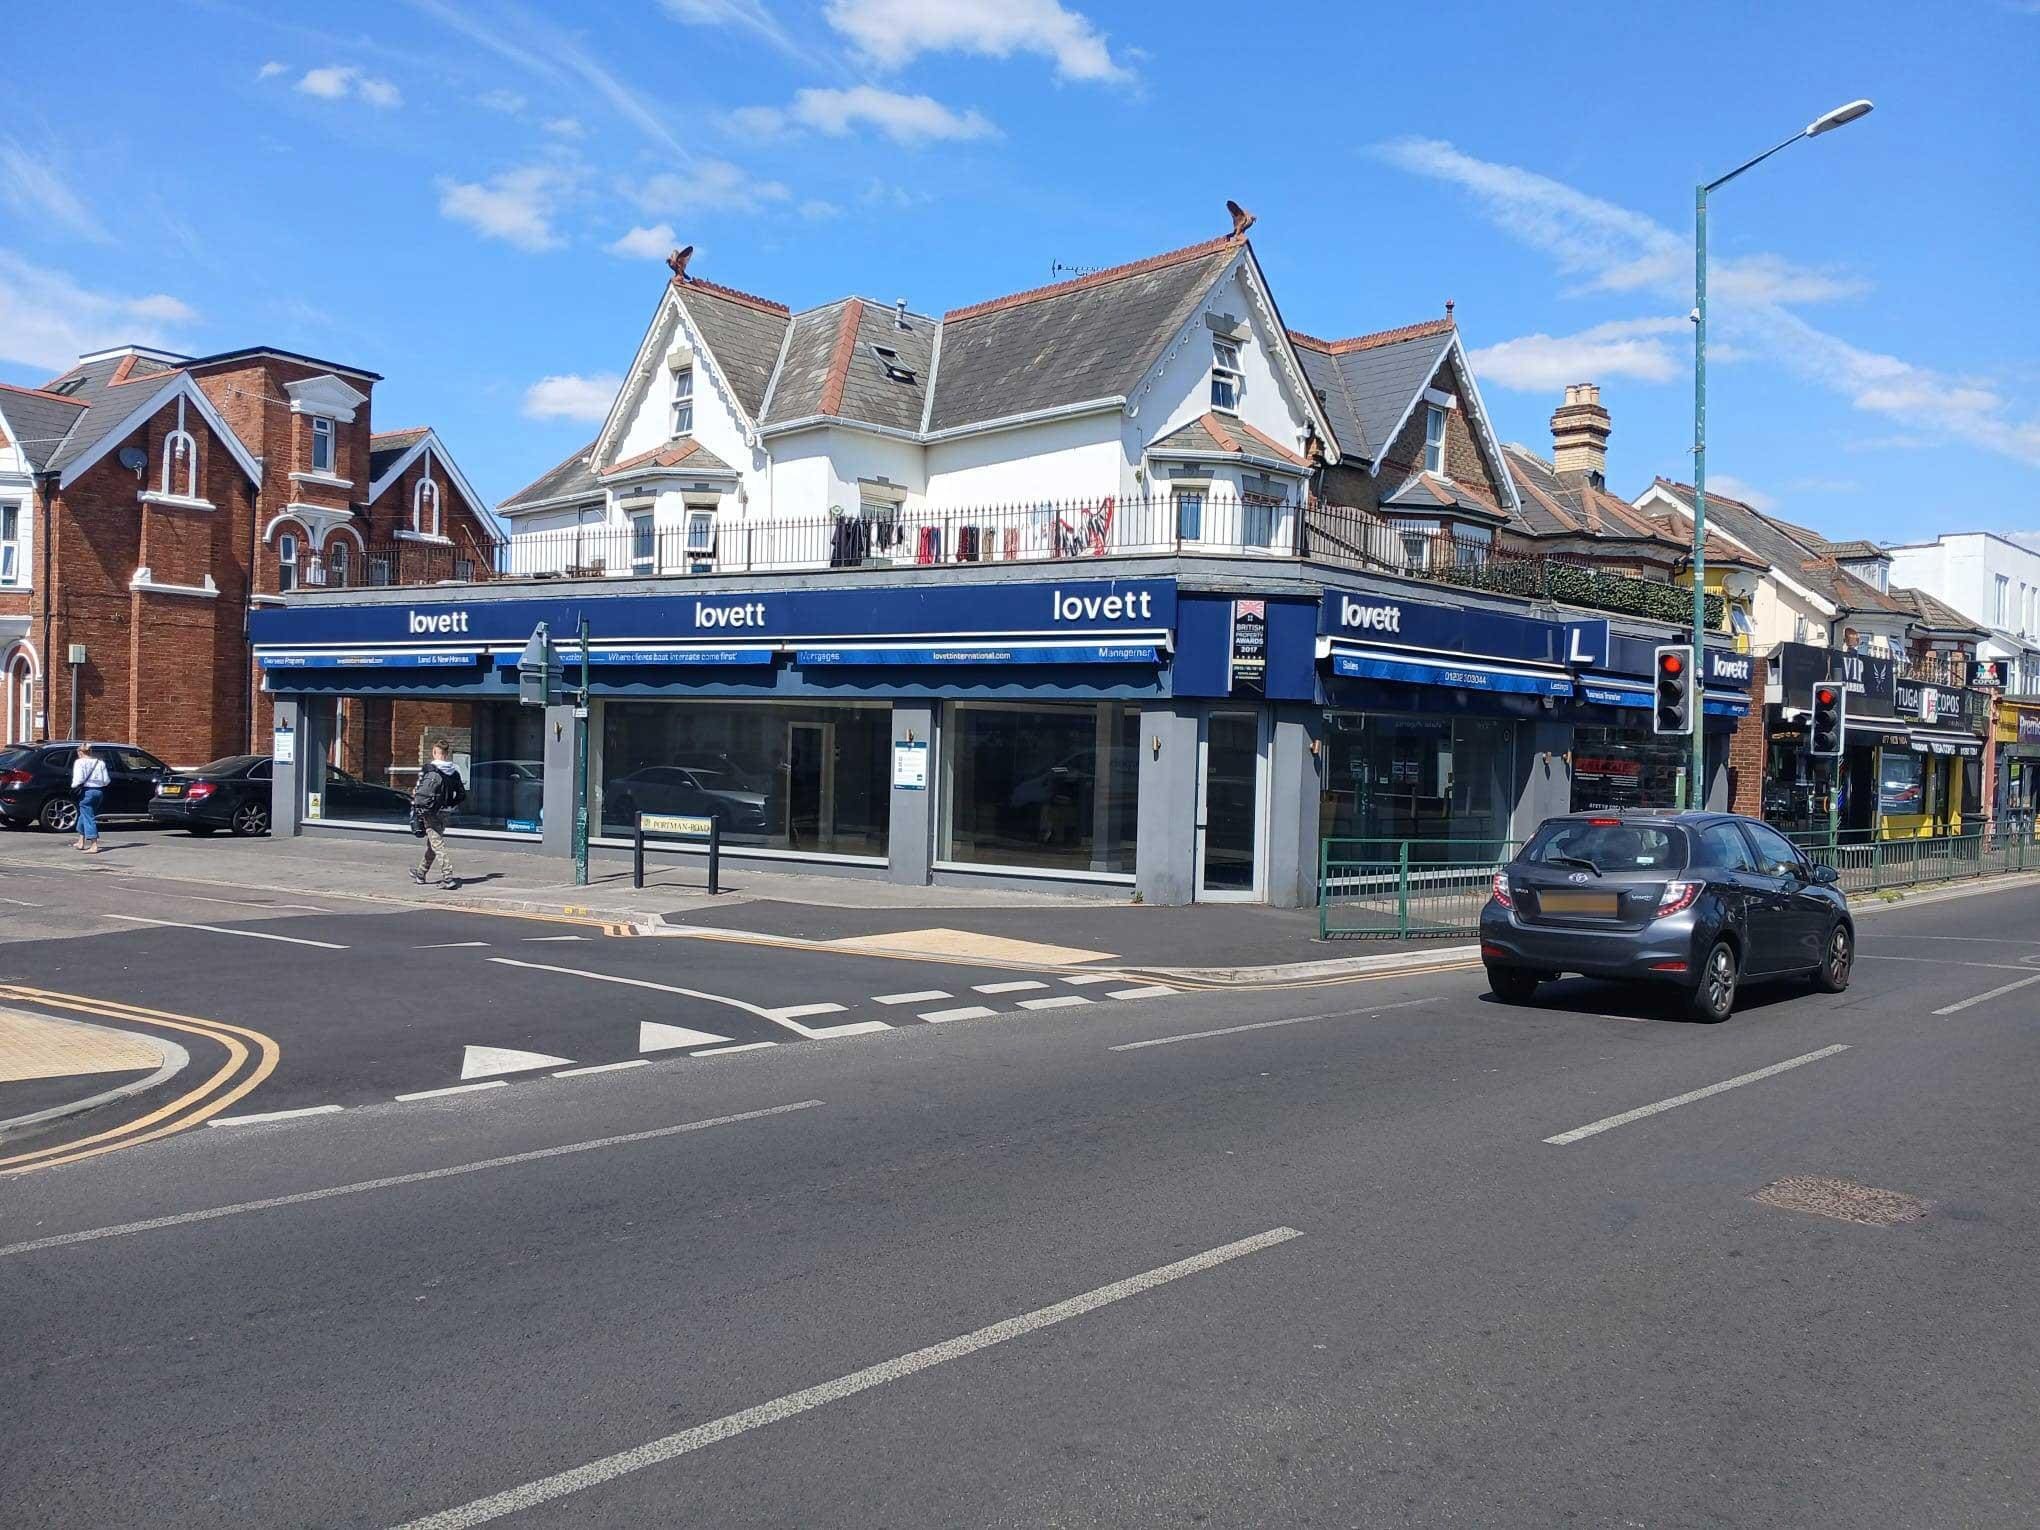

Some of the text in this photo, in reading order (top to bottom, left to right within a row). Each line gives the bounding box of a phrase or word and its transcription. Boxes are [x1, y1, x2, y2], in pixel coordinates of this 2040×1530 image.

[695, 602, 765, 628] lovett
[1054, 591, 1151, 620] lovett
[1341, 596, 1400, 632] lovett
[410, 610, 469, 633] lovett
[1236, 624, 1264, 632] BRITISH
[933, 650, 1011, 660] lovettinternational.com
[1570, 629, 1595, 662] L
[1342, 660, 1358, 672] Sales
[1713, 654, 1749, 680] lovett
[1843, 657, 1864, 681] VIP
[1897, 687, 1960, 713] TUGA COPOS
[653, 820, 687, 830] PORTMAN
